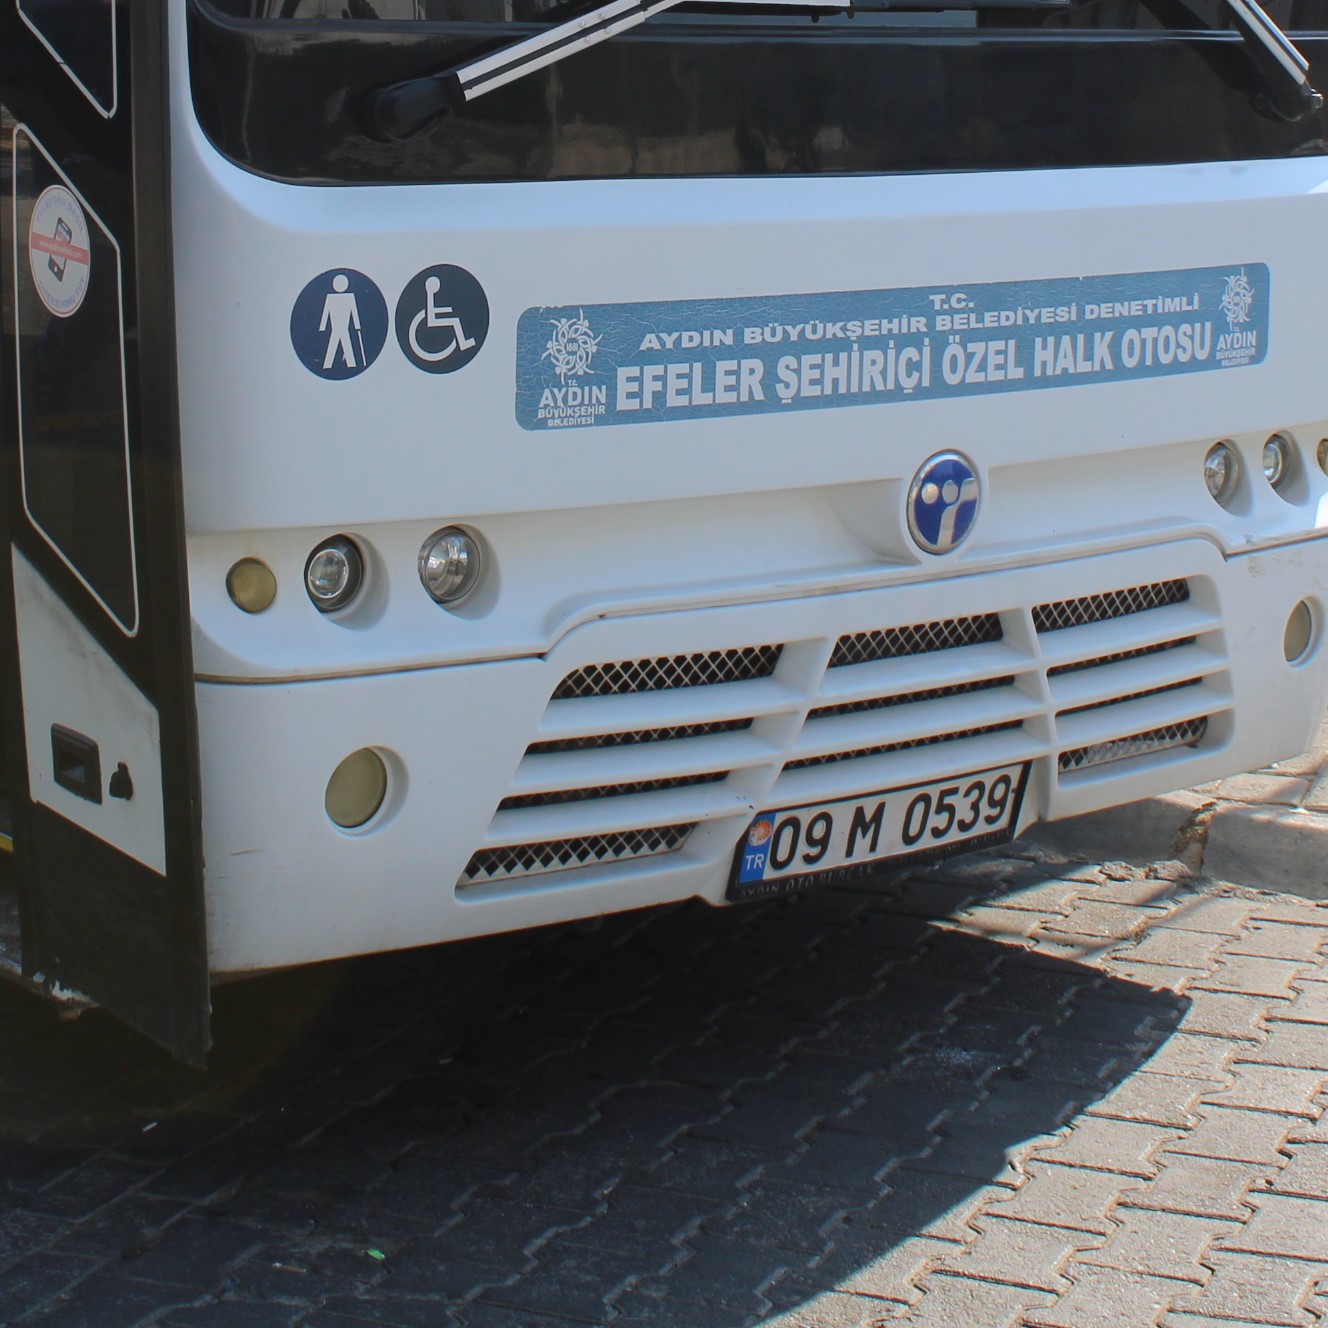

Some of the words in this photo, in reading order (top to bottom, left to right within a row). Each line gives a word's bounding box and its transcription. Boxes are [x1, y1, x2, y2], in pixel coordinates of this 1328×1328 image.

[639, 329, 734, 351] AYDIN
[744, 314, 928, 345] BÜYÜKŞEHİR
[935, 302, 1078, 332] BELEDİYESİ
[1084, 292, 1200, 320] DENETİMLİ
[929, 293, 976, 311] T.C.
[1216, 330, 1257, 351] AYDIN
[615, 358, 766, 412] EFELER
[775, 337, 931, 405] ŞEHİRİÇİ
[942, 335, 1024, 386] ÖZEL
[1033, 330, 1115, 377] HALK
[1121, 321, 1212, 369] OTOSU
[538, 385, 607, 408] AYDIN
[745, 852, 765, 870] TR
[769, 811, 834, 871] 09
[845, 801, 886, 859] M
[901, 773, 1013, 847] 0539
